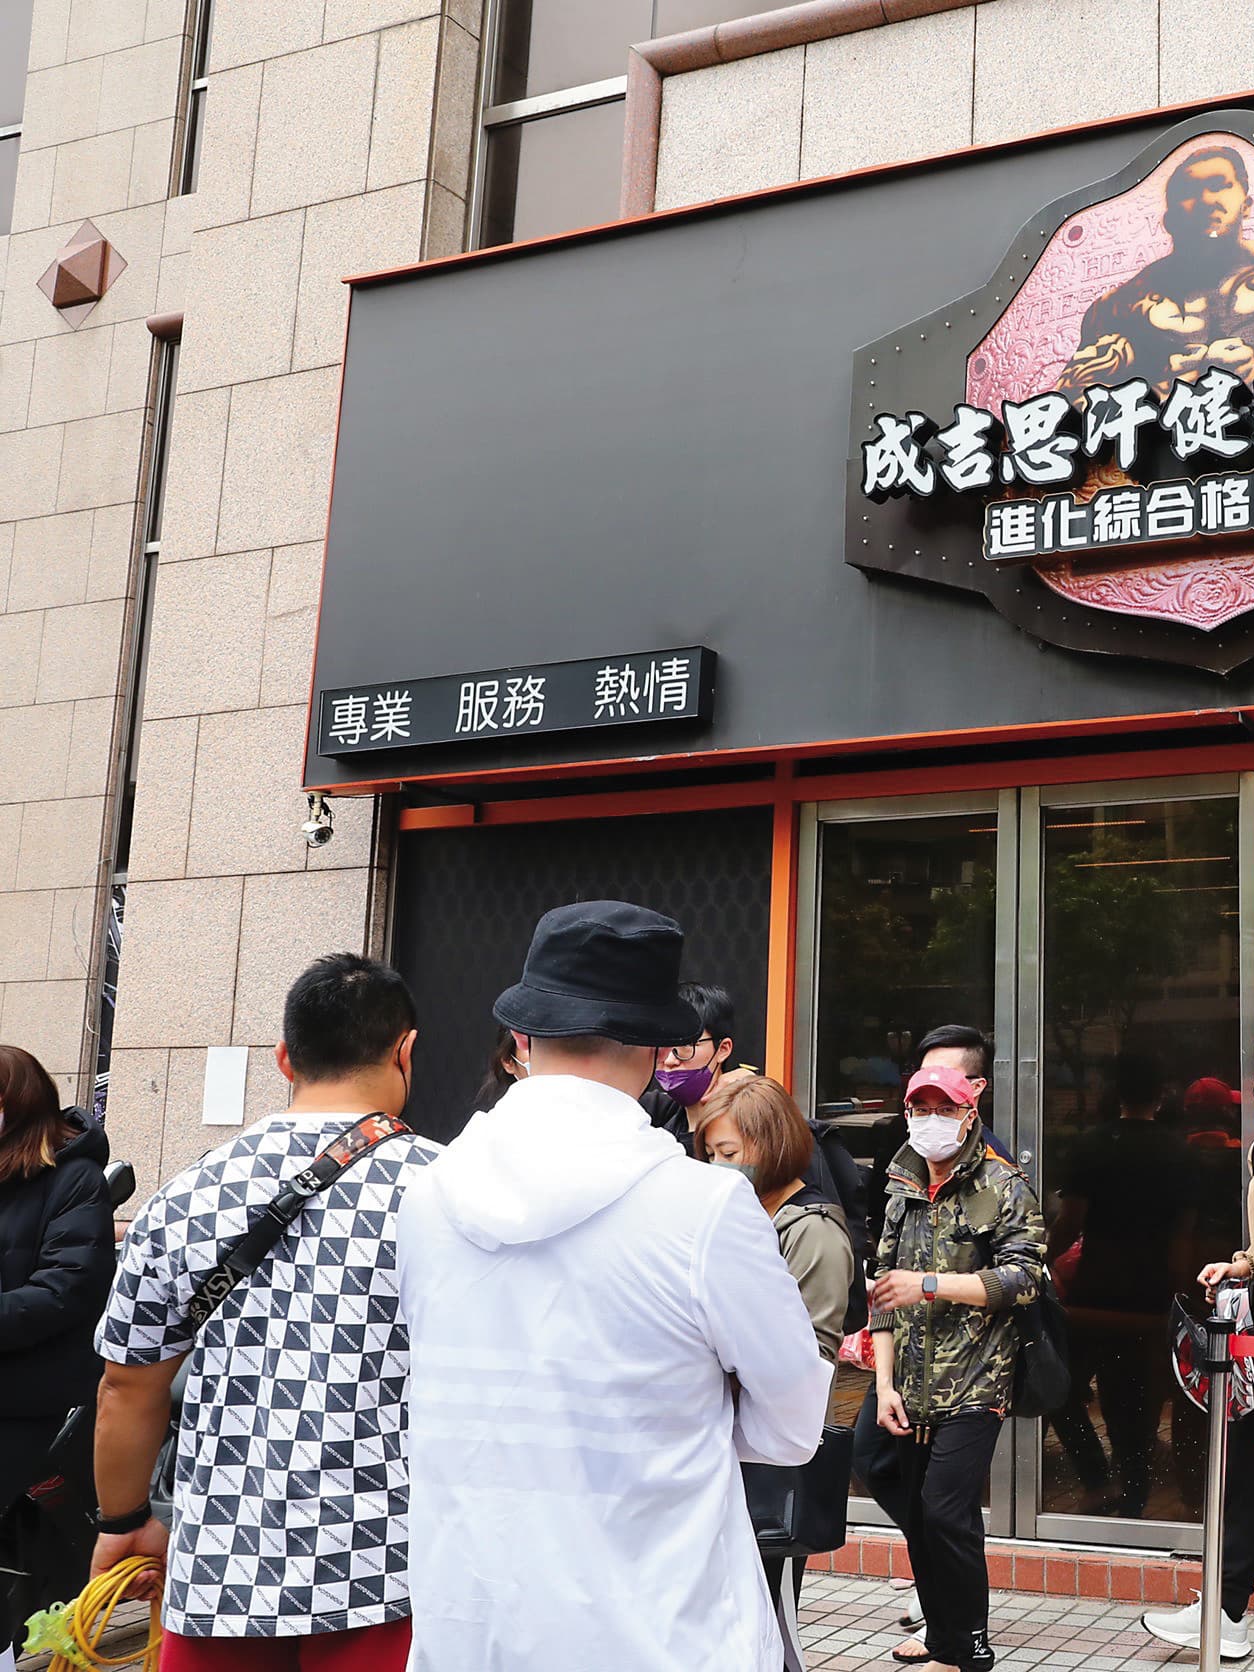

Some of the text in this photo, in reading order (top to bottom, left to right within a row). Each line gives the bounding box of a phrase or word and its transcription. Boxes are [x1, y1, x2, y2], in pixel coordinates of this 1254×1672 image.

[328, 657, 691, 746] 專業 服務 熱情
